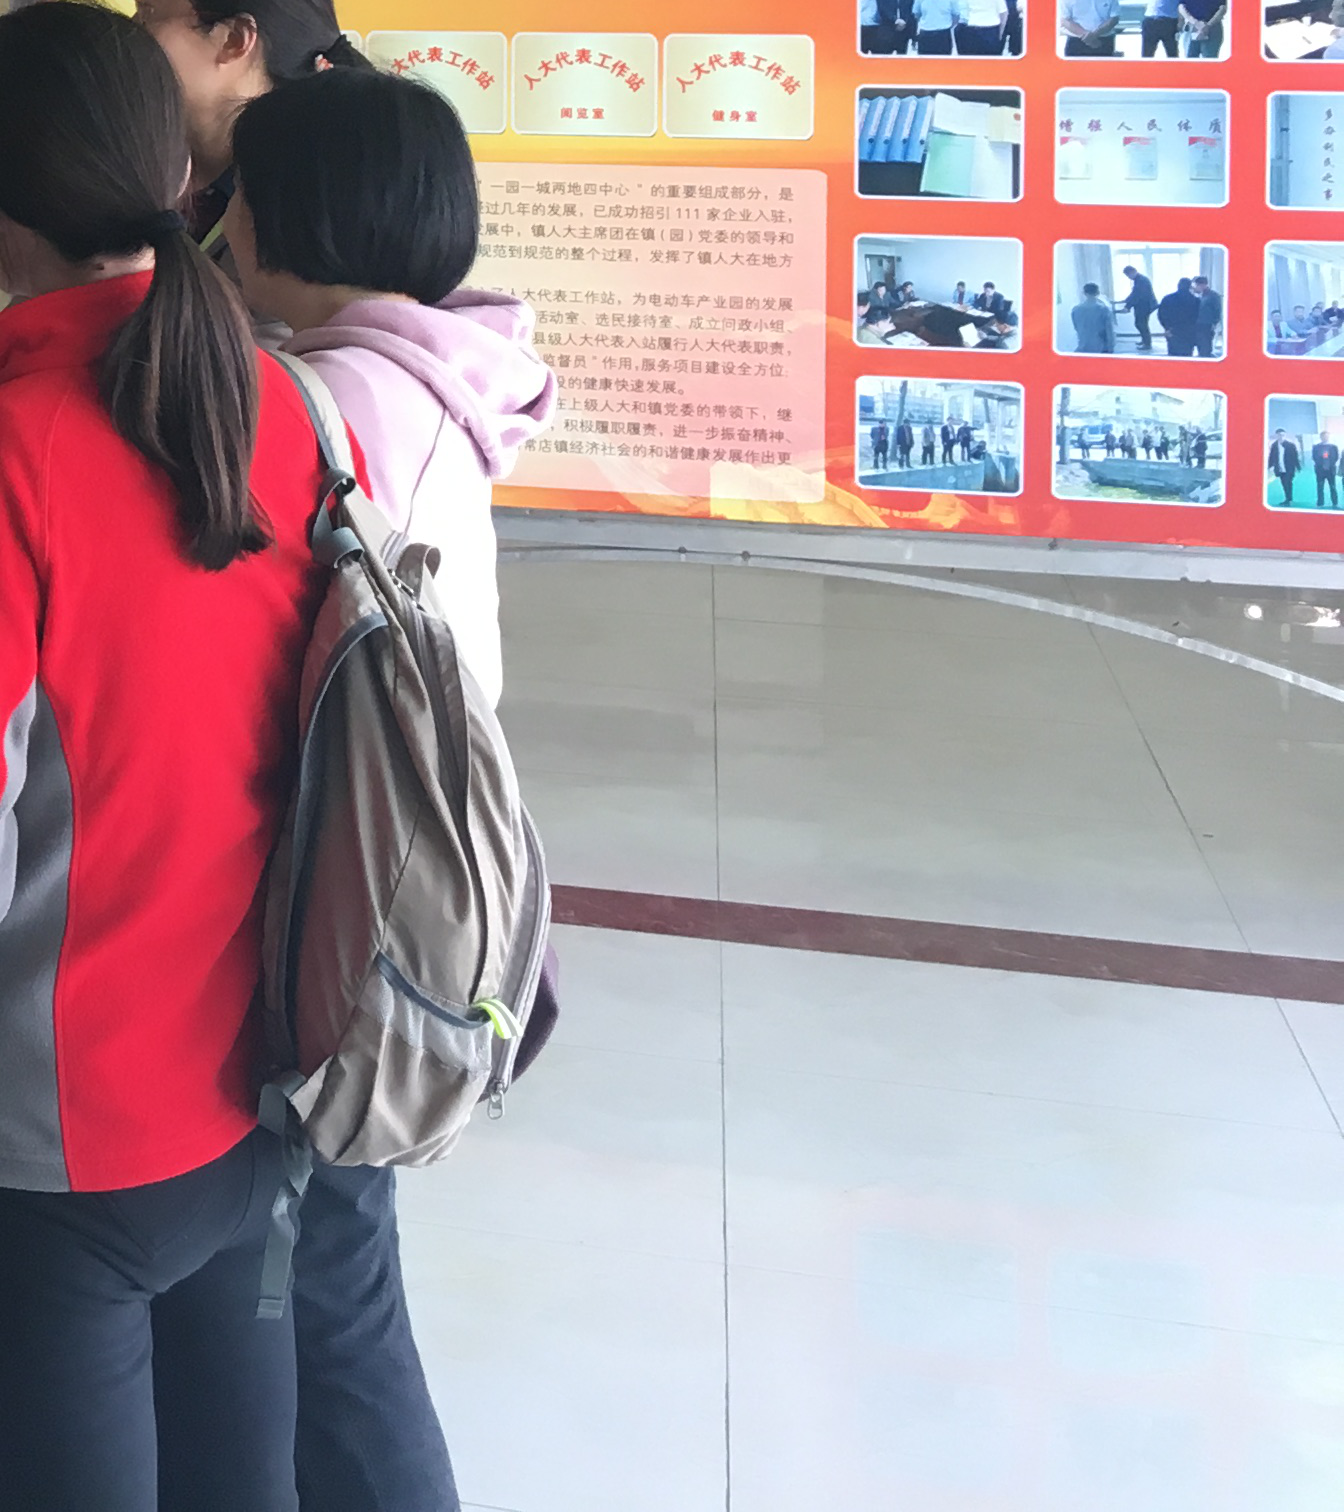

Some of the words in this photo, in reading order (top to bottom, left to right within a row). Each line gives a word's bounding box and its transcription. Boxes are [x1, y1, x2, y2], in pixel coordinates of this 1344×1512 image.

[523, 48, 646, 94] 人大代表工作站
[675, 50, 802, 97] 人大代表工作站
[712, 110, 758, 123] 健身室
